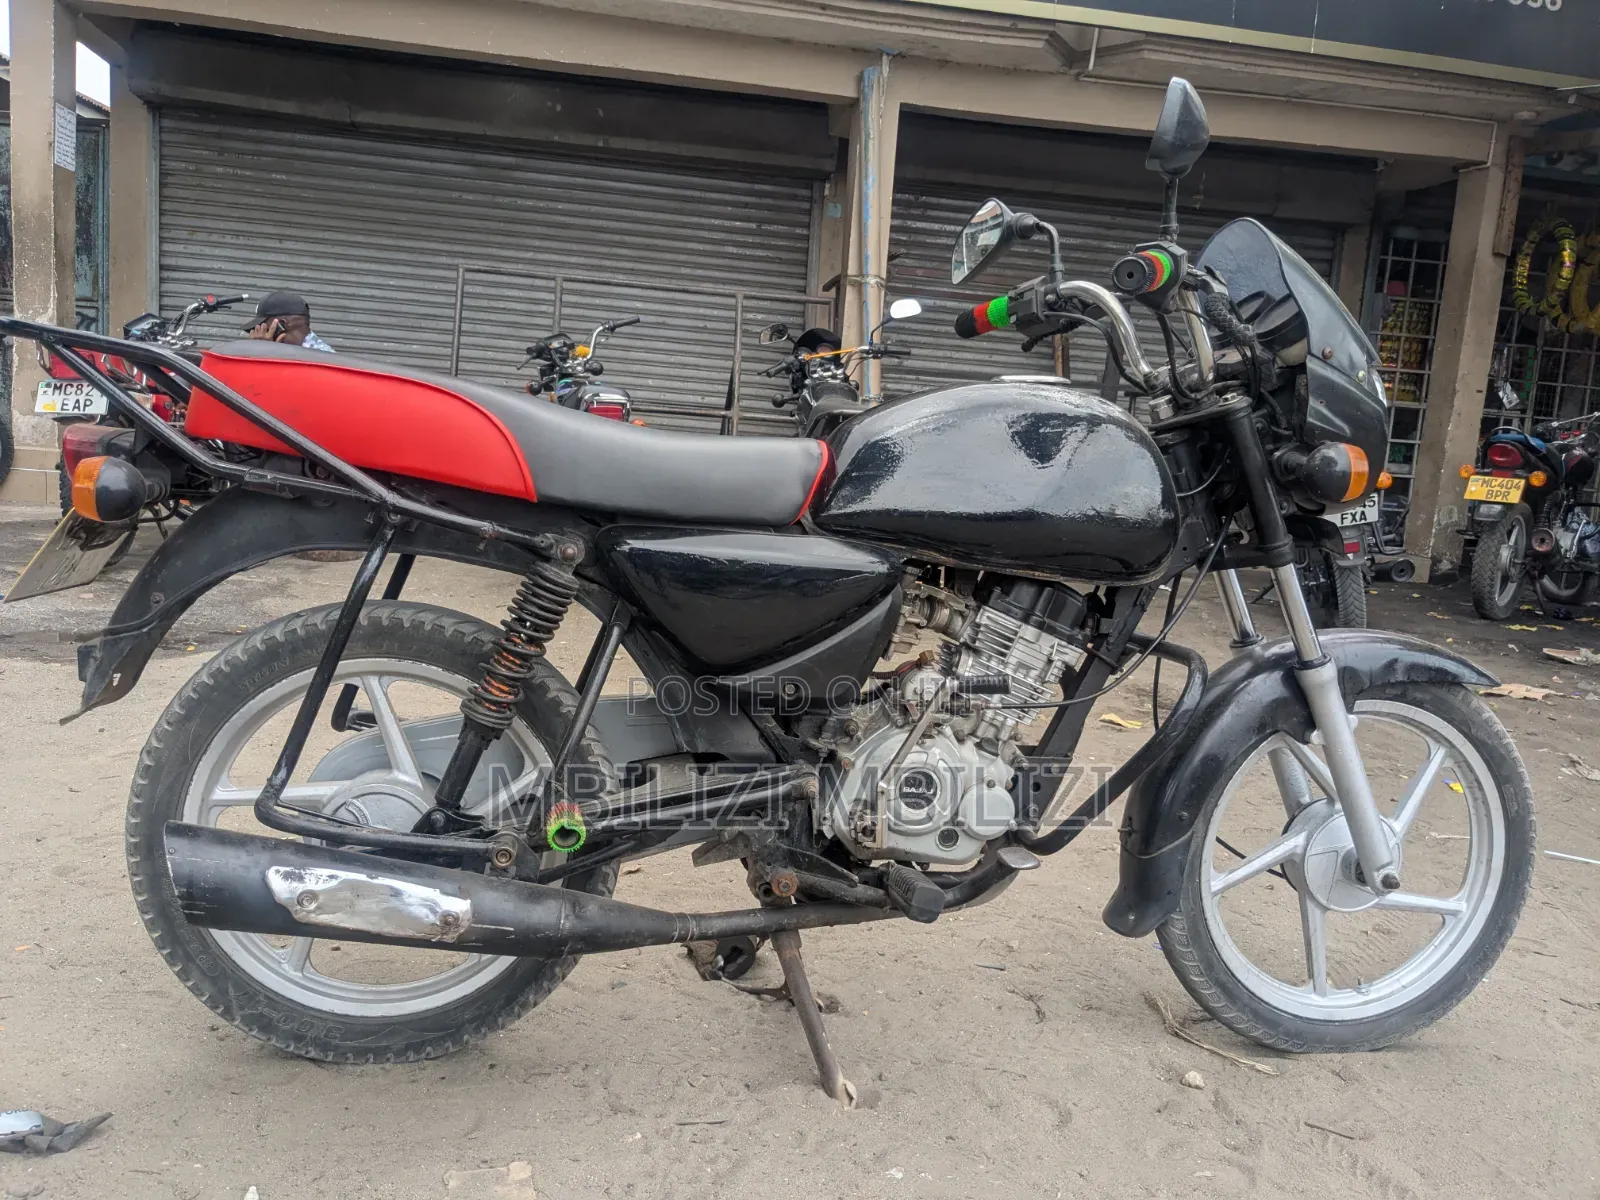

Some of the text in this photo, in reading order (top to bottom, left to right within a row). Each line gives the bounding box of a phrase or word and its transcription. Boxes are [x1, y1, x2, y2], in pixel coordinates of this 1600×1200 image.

[52, 383, 103, 397] MC82
[60, 398, 93, 412] EAP
[1480, 477, 1521, 491] MC404
[1485, 489, 1511, 501] BPR
[1341, 510, 1367, 525] FXA
[903, 786, 934, 795] BAJAJ
